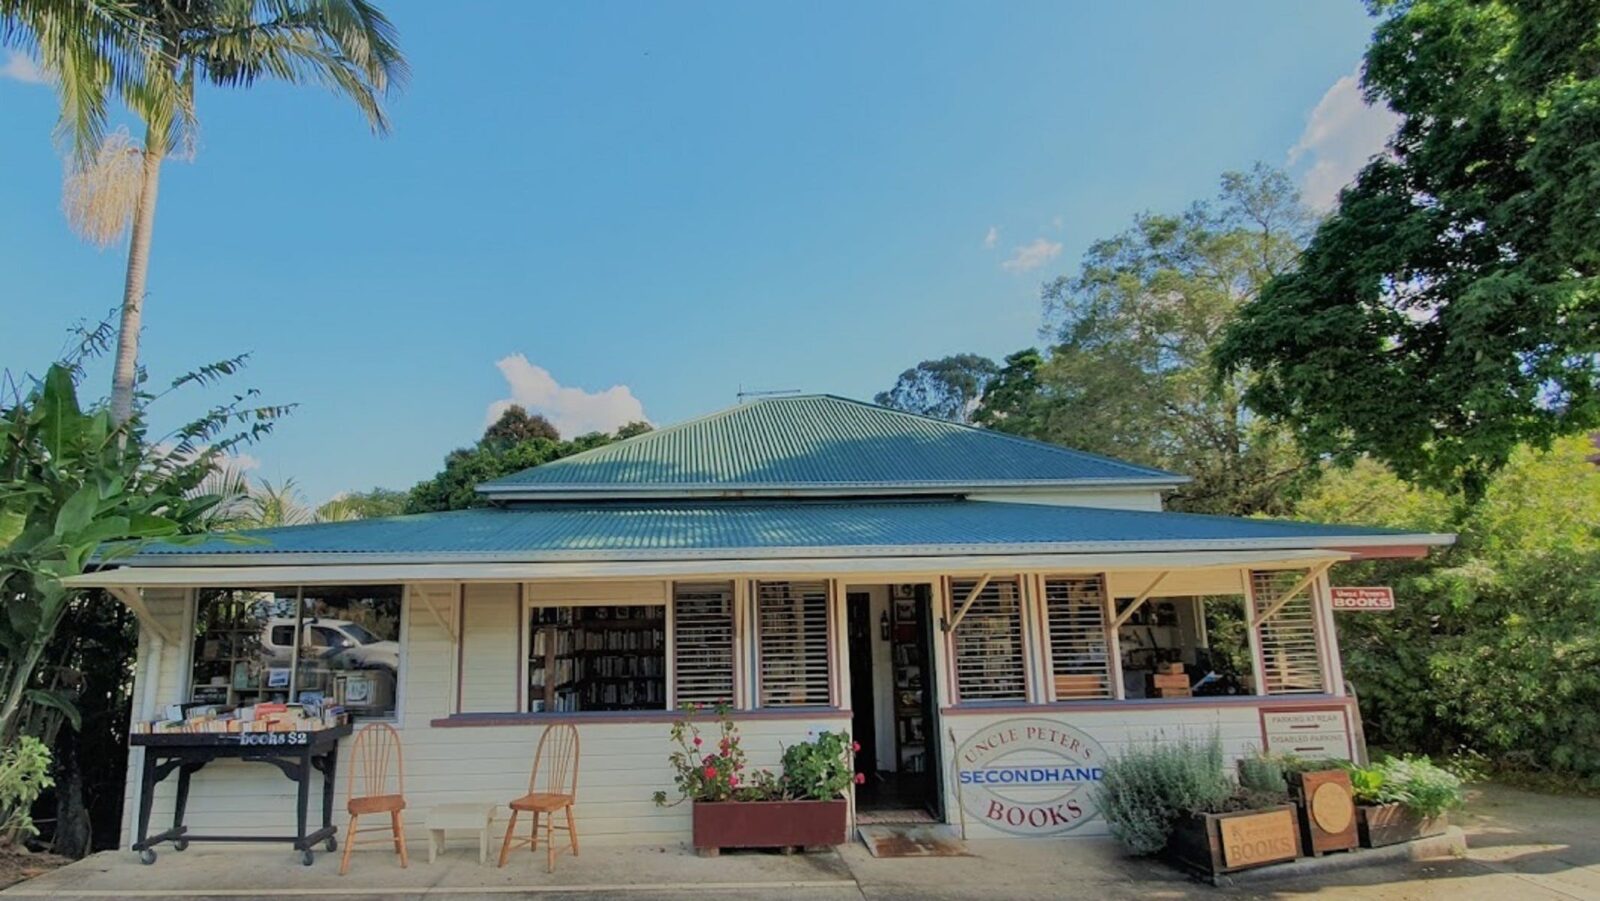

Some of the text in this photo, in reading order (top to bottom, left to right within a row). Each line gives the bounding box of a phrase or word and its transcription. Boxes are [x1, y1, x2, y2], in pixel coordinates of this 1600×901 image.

[1334, 598, 1391, 607] BOOKS
[1272, 715, 1304, 723] PARKING
[964, 727, 1092, 763] UNCLE PETER'S
[959, 768, 1105, 784] SECONDHAND
[986, 799, 1082, 828] BOOKS
[1229, 837, 1291, 861] BOOKS
